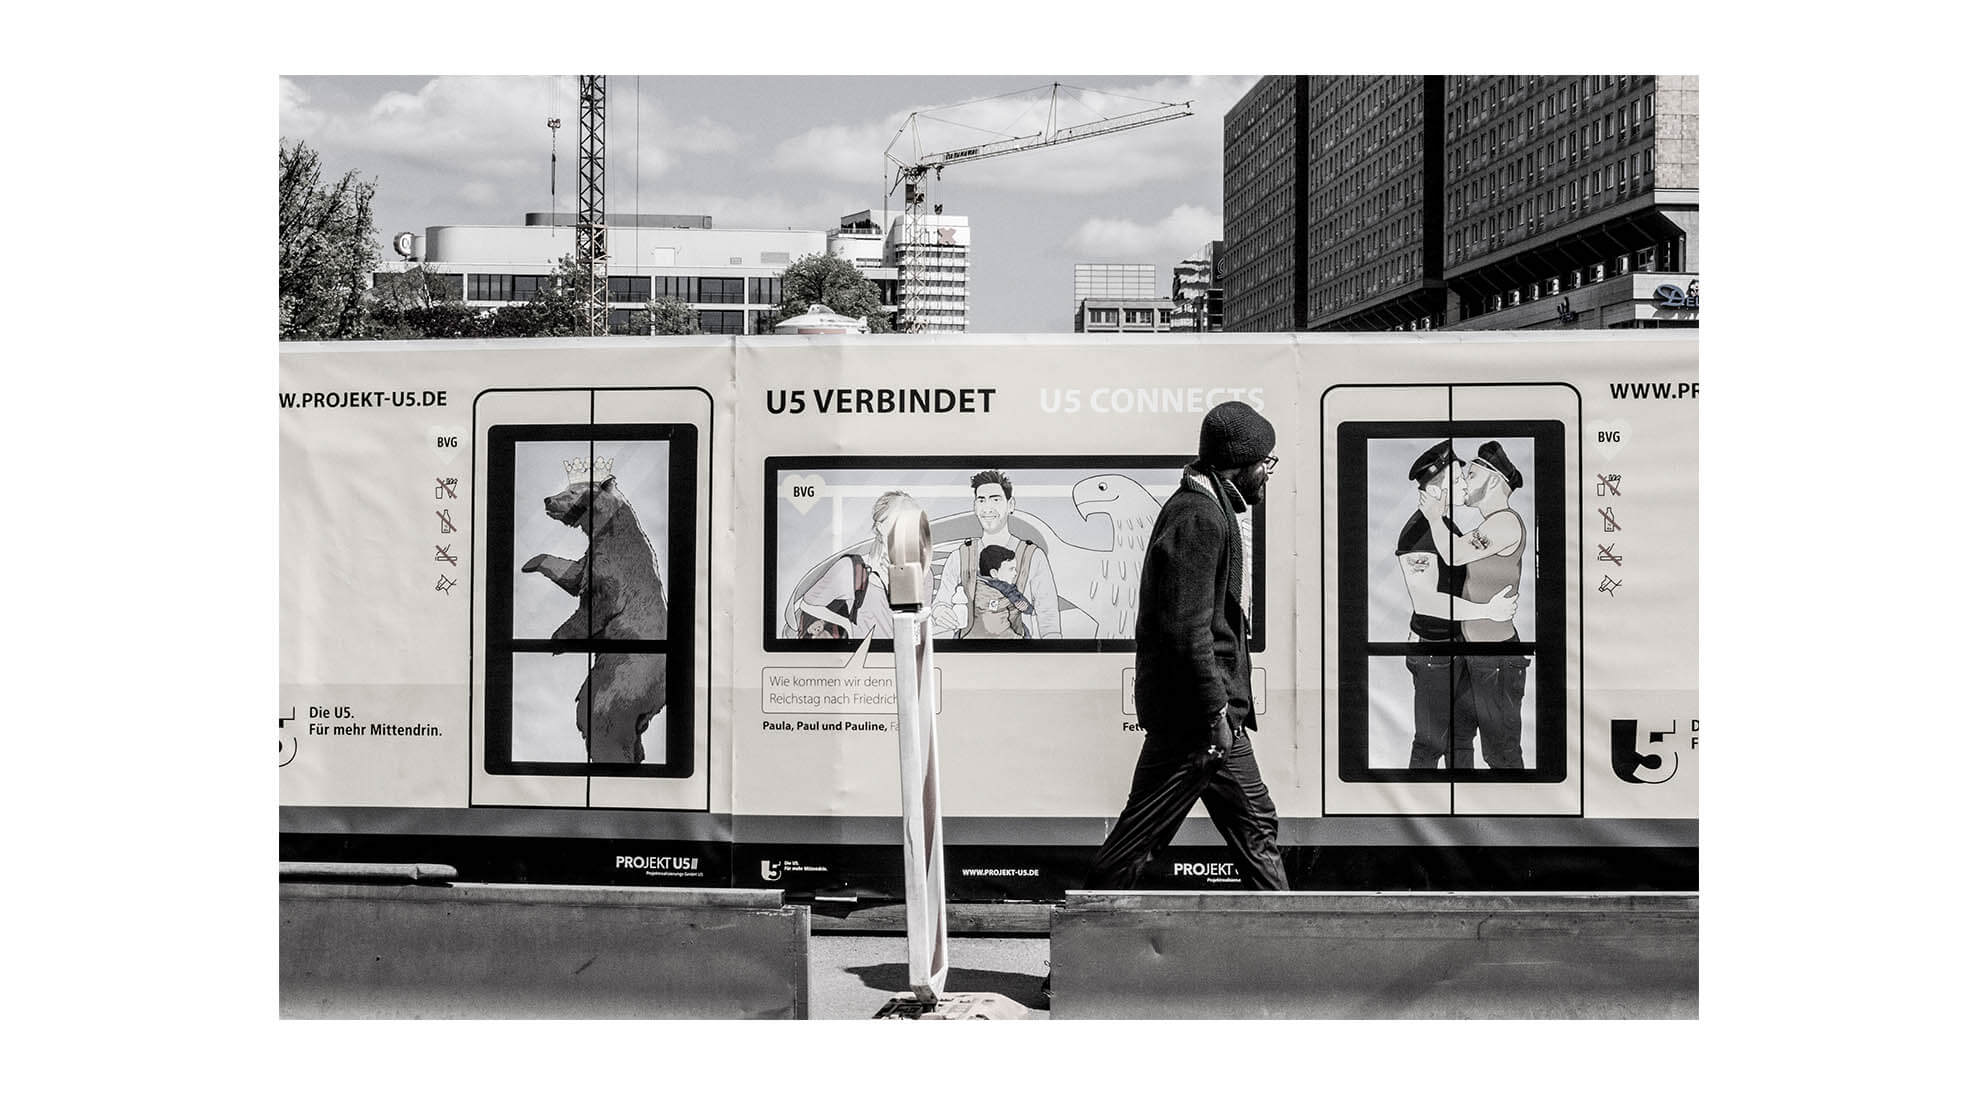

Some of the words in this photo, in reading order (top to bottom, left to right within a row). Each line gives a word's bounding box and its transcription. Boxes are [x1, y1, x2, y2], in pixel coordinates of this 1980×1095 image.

[279, 391, 447, 408] W.PROJEKT-U5.DE
[766, 390, 806, 414] U5
[813, 389, 996, 413] VERBINDET
[1040, 388, 1081, 413] U5
[437, 437, 458, 448] BVG
[1598, 431, 1621, 443] BVG
[793, 486, 815, 497] BVG
[769, 676, 790, 687] Wie
[793, 676, 841, 687] kommen
[844, 677, 860, 687] wir
[863, 677, 893, 687] denn
[769, 693, 821, 707] Reichstag
[823, 694, 849, 704] nach
[309, 707, 330, 718] Die
[334, 707, 354, 718] U5.
[309, 724, 329, 735] Für
[334, 724, 366, 735] mehr
[371, 724, 442, 736] Mittendrin.
[763, 721, 794, 731] Paula,
[797, 722, 819, 730] Paul
[822, 722, 842, 730] und
[845, 722, 887, 732] Pauline,
[616, 856, 672, 869] PROJEKT
[673, 857, 690, 869] U5
[1174, 863, 1234, 875] PROJEKT
